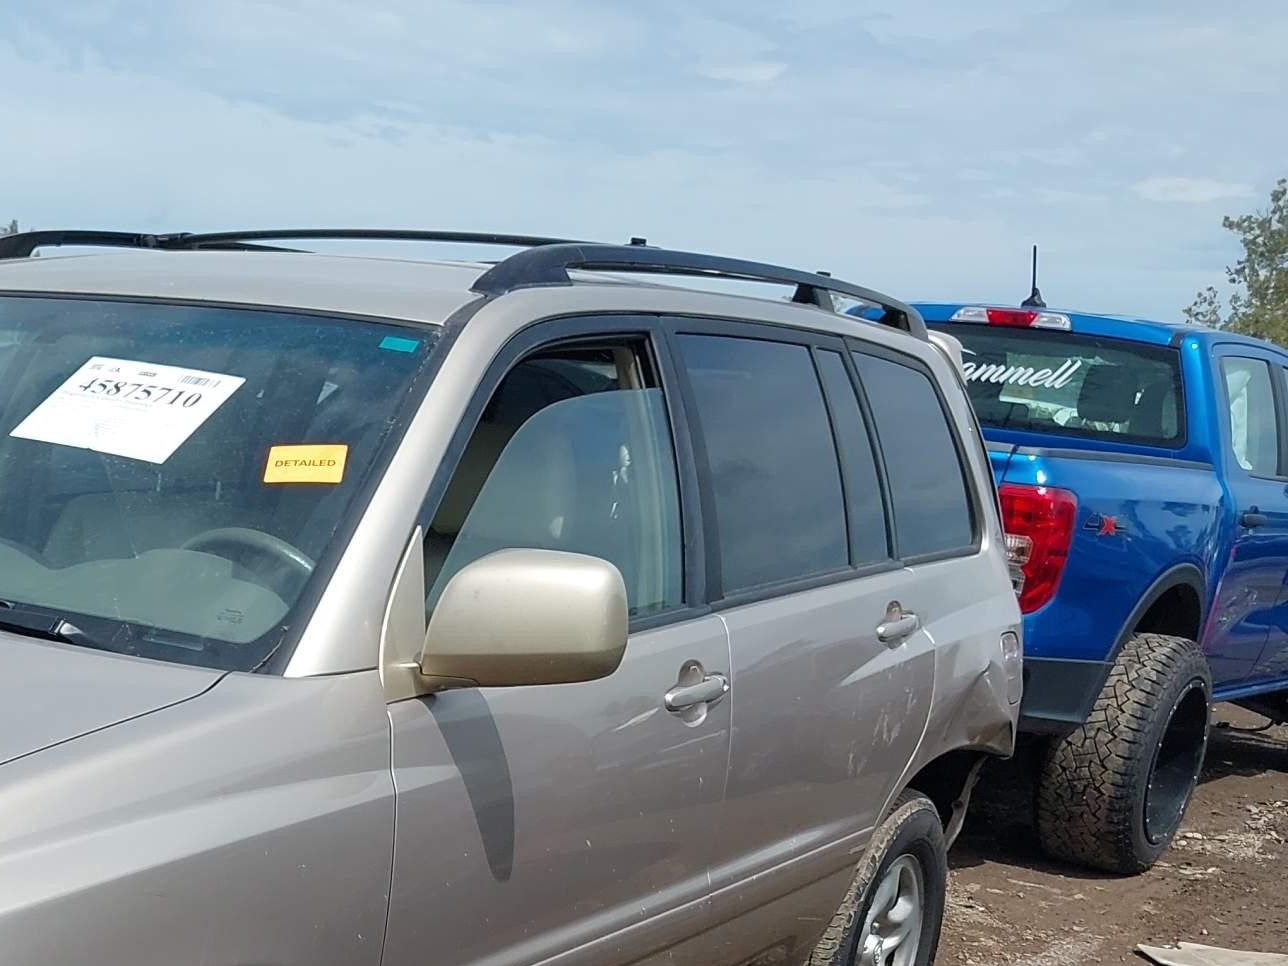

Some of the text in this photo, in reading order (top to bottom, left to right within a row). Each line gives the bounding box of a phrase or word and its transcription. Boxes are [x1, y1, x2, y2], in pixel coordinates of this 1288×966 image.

[962, 349, 1082, 389] ammell
[79, 377, 203, 408] 45875710
[274, 459, 336, 468] DETAILED
